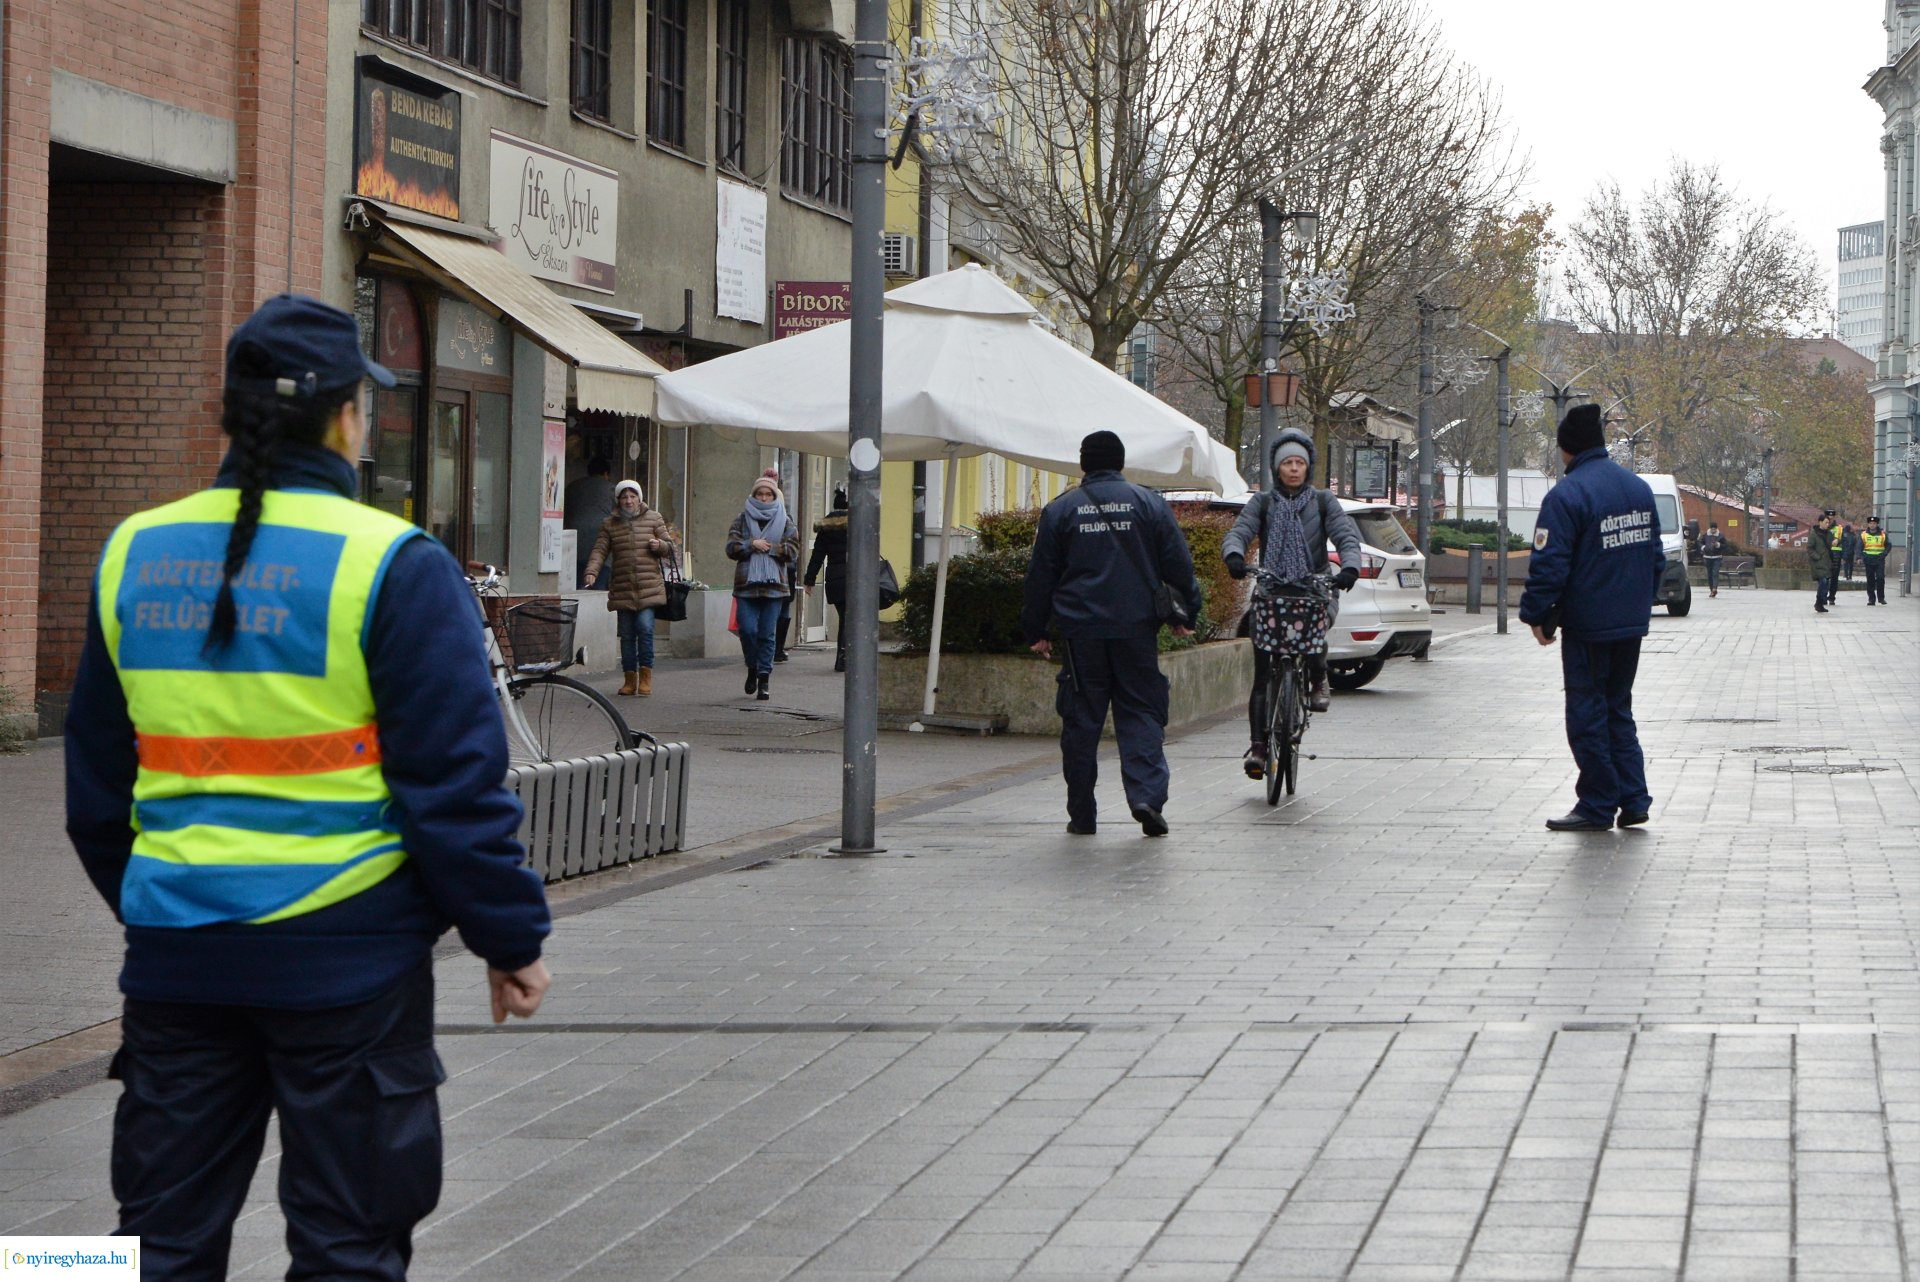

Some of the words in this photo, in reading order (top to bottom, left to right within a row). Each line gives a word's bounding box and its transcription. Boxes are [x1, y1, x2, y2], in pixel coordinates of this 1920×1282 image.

[391, 90, 422, 120] BENDA
[423, 101, 453, 130] KEBAB
[390, 137, 426, 163] AUTHENTIC
[426, 147, 454, 170] TURKISH
[511, 156, 550, 260] Life
[559, 168, 599, 249] Style
[781, 291, 845, 312] BÍBOR
[779, 314, 845, 328] LAKÁSTEXT
[135, 596, 290, 635] FELÜGLET
